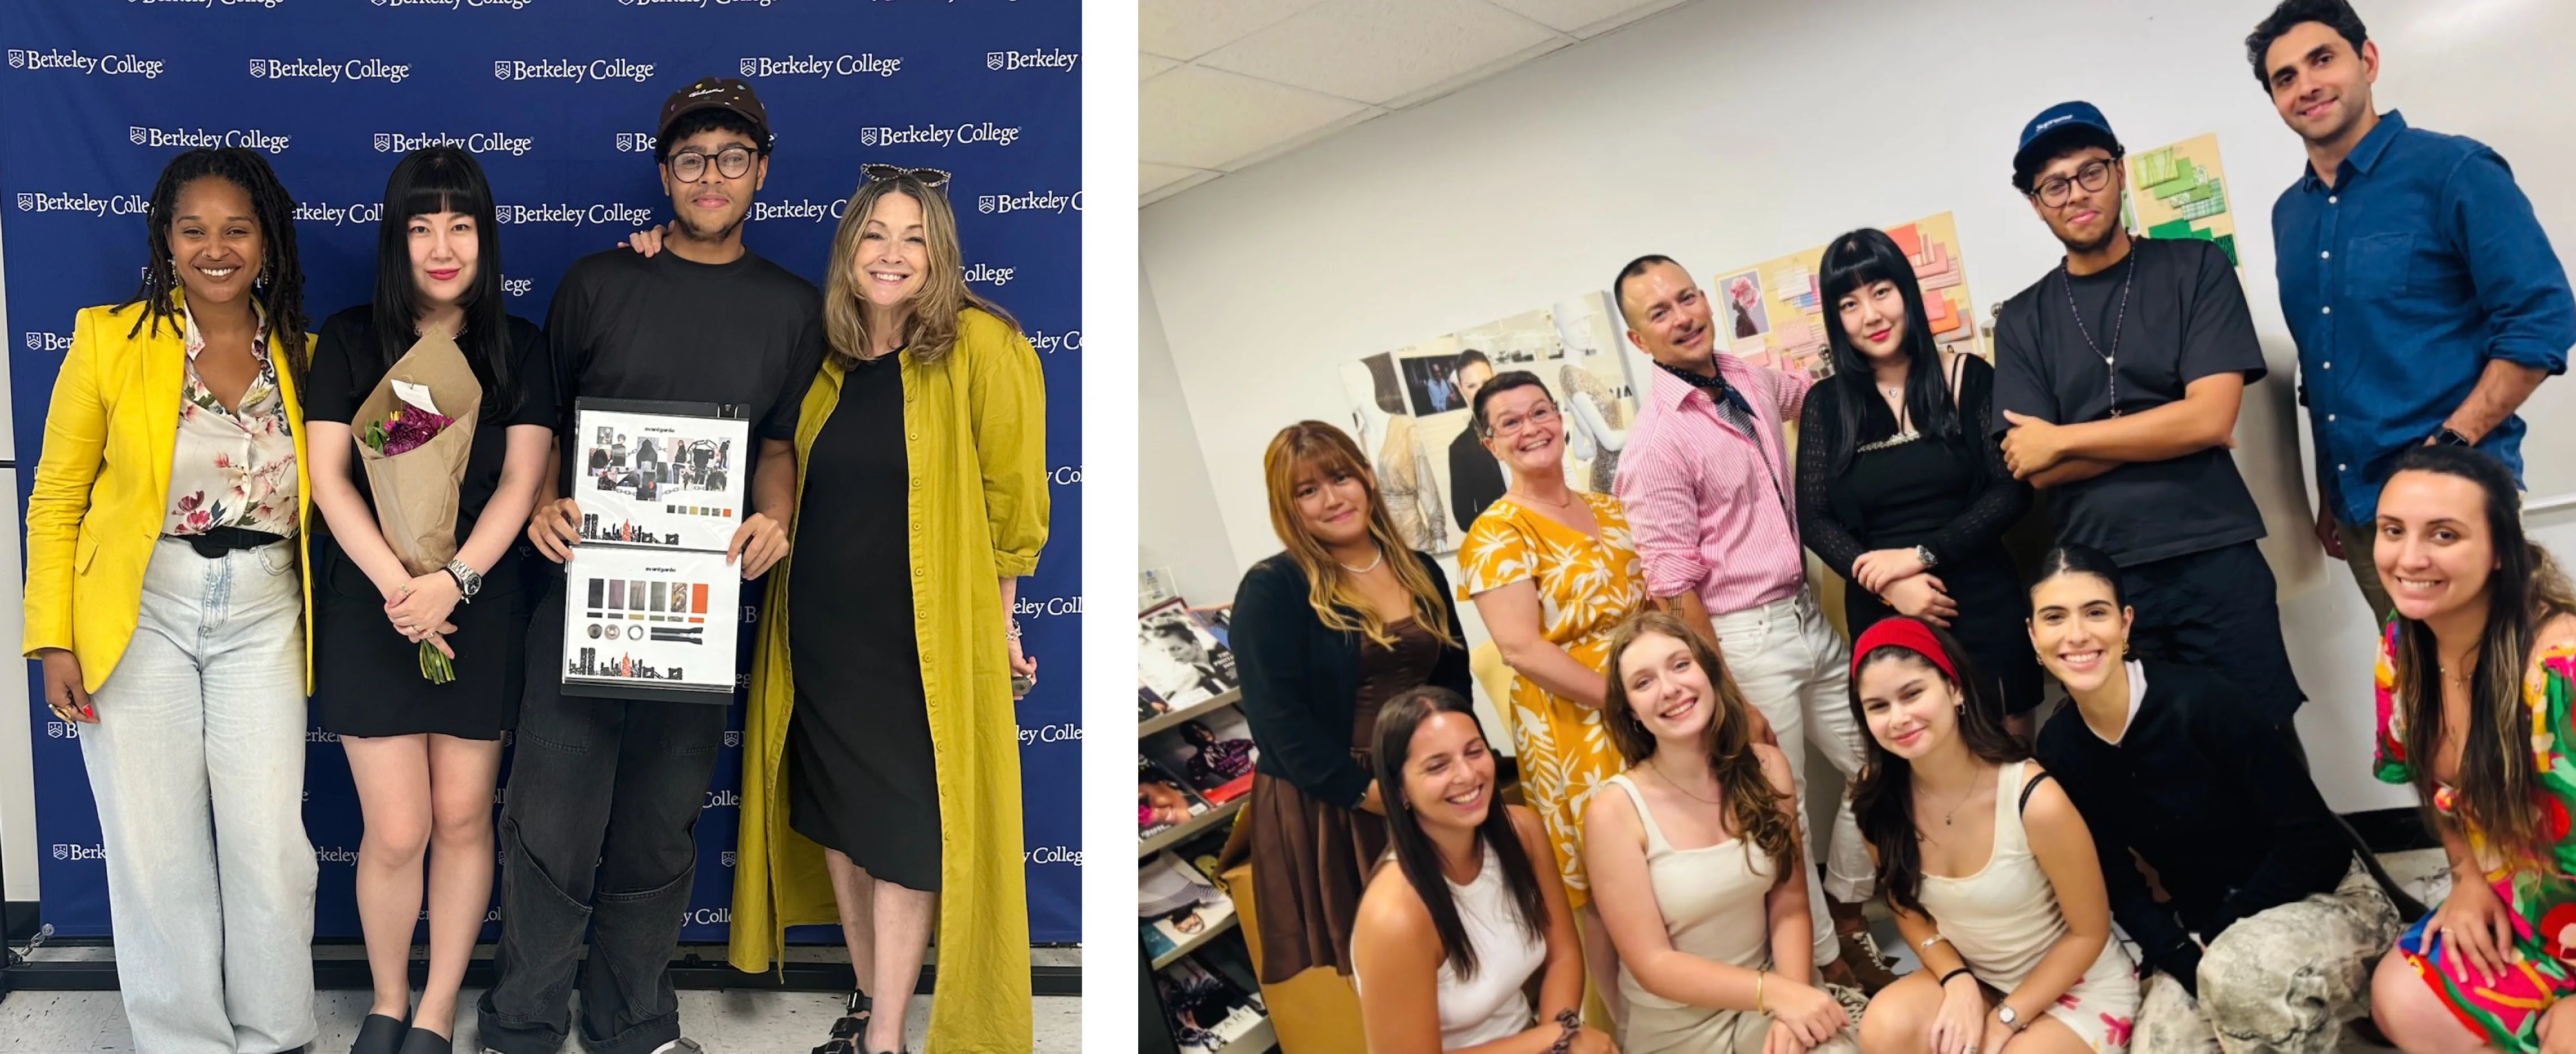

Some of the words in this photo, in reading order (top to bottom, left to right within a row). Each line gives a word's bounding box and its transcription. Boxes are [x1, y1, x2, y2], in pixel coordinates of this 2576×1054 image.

[26, 48, 97, 74] Berkeley
[101, 55, 163, 78] College
[268, 58, 342, 83] Berkeley
[345, 59, 409, 83] College
[513, 59, 587, 83] Berkeley
[590, 58, 654, 82] College
[759, 55, 833, 79] Berkeley
[836, 53, 900, 77] College
[1006, 48, 1078, 72] Berkeley
[149, 128, 222, 151] Berkeley
[225, 130, 289, 153] College
[468, 133, 531, 156] College
[880, 124, 954, 147] Berkeley
[957, 123, 1019, 146] College
[35, 192, 108, 217] Berkeley
[111, 195, 150, 215] Colle
[754, 199, 827, 223] Berkeley
[998, 190, 1069, 214] Berkeley
[514, 203, 586, 227] Berkeley
[589, 203, 651, 225] College
[1025, 331, 1061, 354] eley
